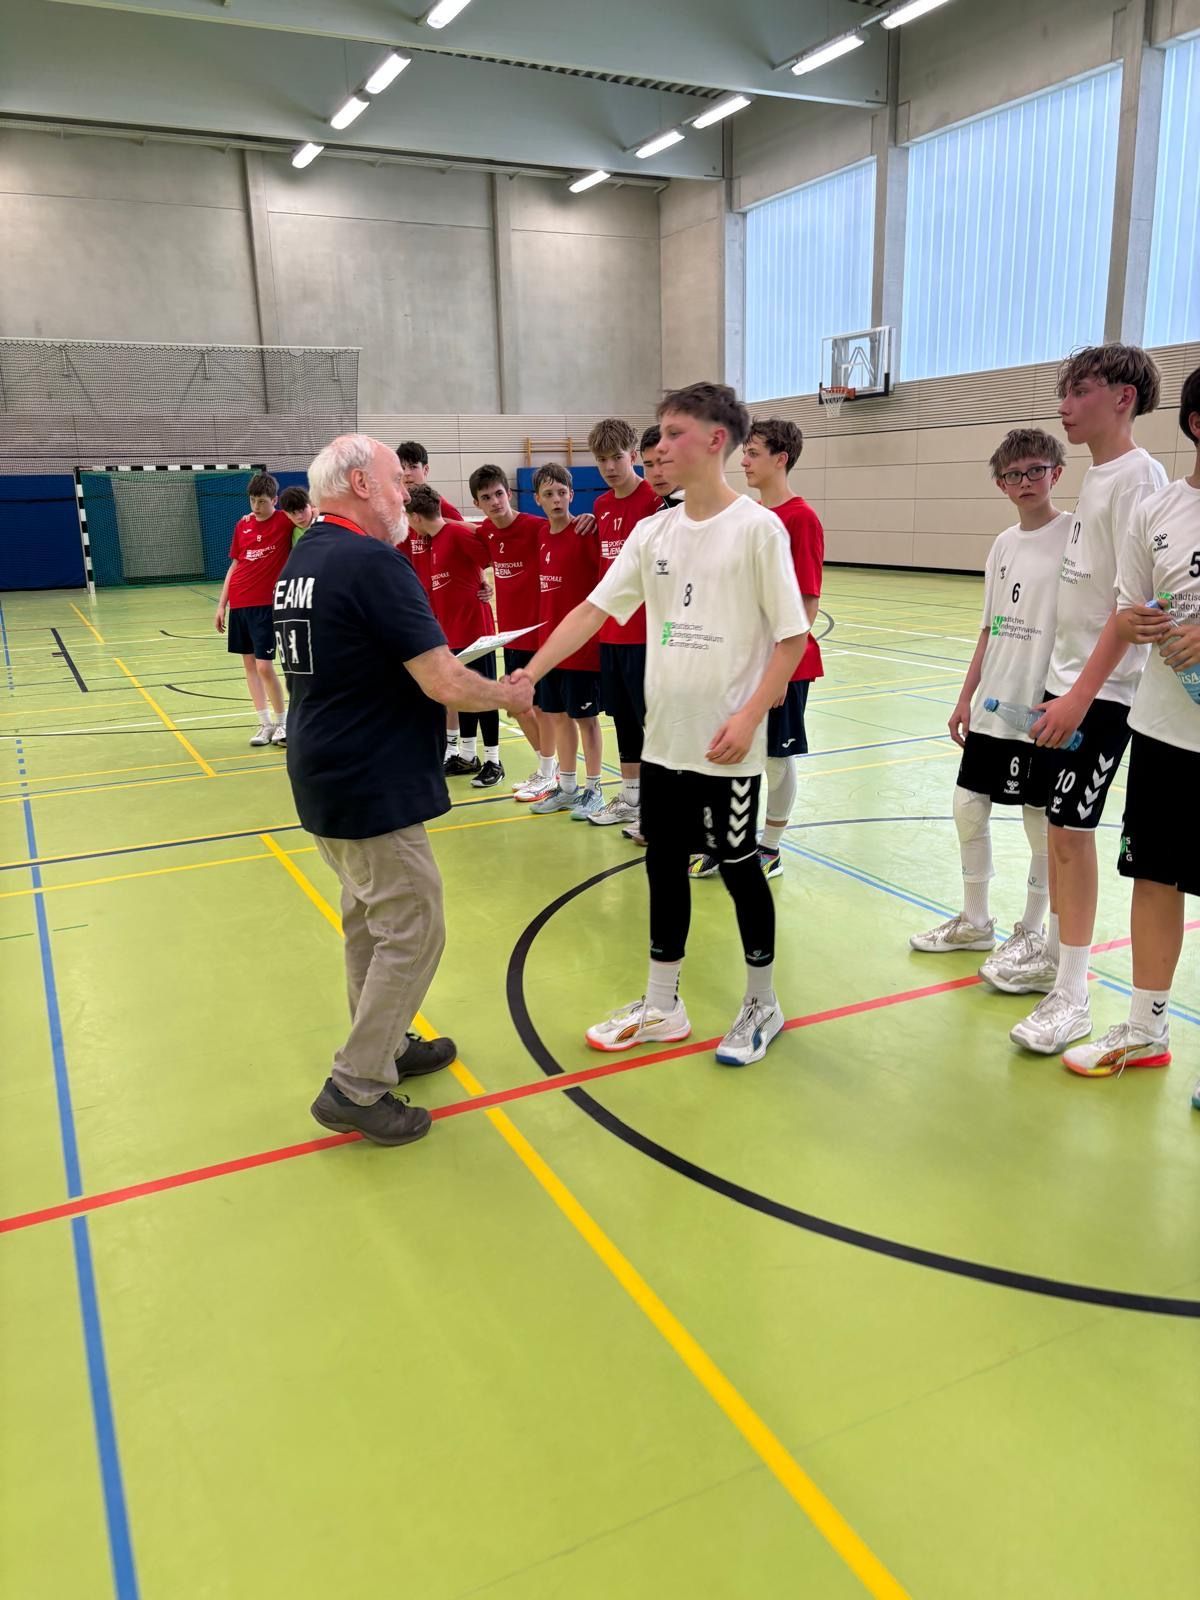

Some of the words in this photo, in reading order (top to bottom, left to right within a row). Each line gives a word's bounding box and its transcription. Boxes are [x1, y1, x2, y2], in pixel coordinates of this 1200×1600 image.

[613, 517, 623, 531] 17
[499, 542, 504, 554] 2
[544, 551, 551, 564] 4
[1188, 551, 1200, 578] 5
[272, 577, 315, 611] EAM
[683, 582, 693, 608] 8
[1011, 582, 1021, 604] 6
[1009, 756, 1020, 777] 6
[1054, 768, 1077, 794] 10
